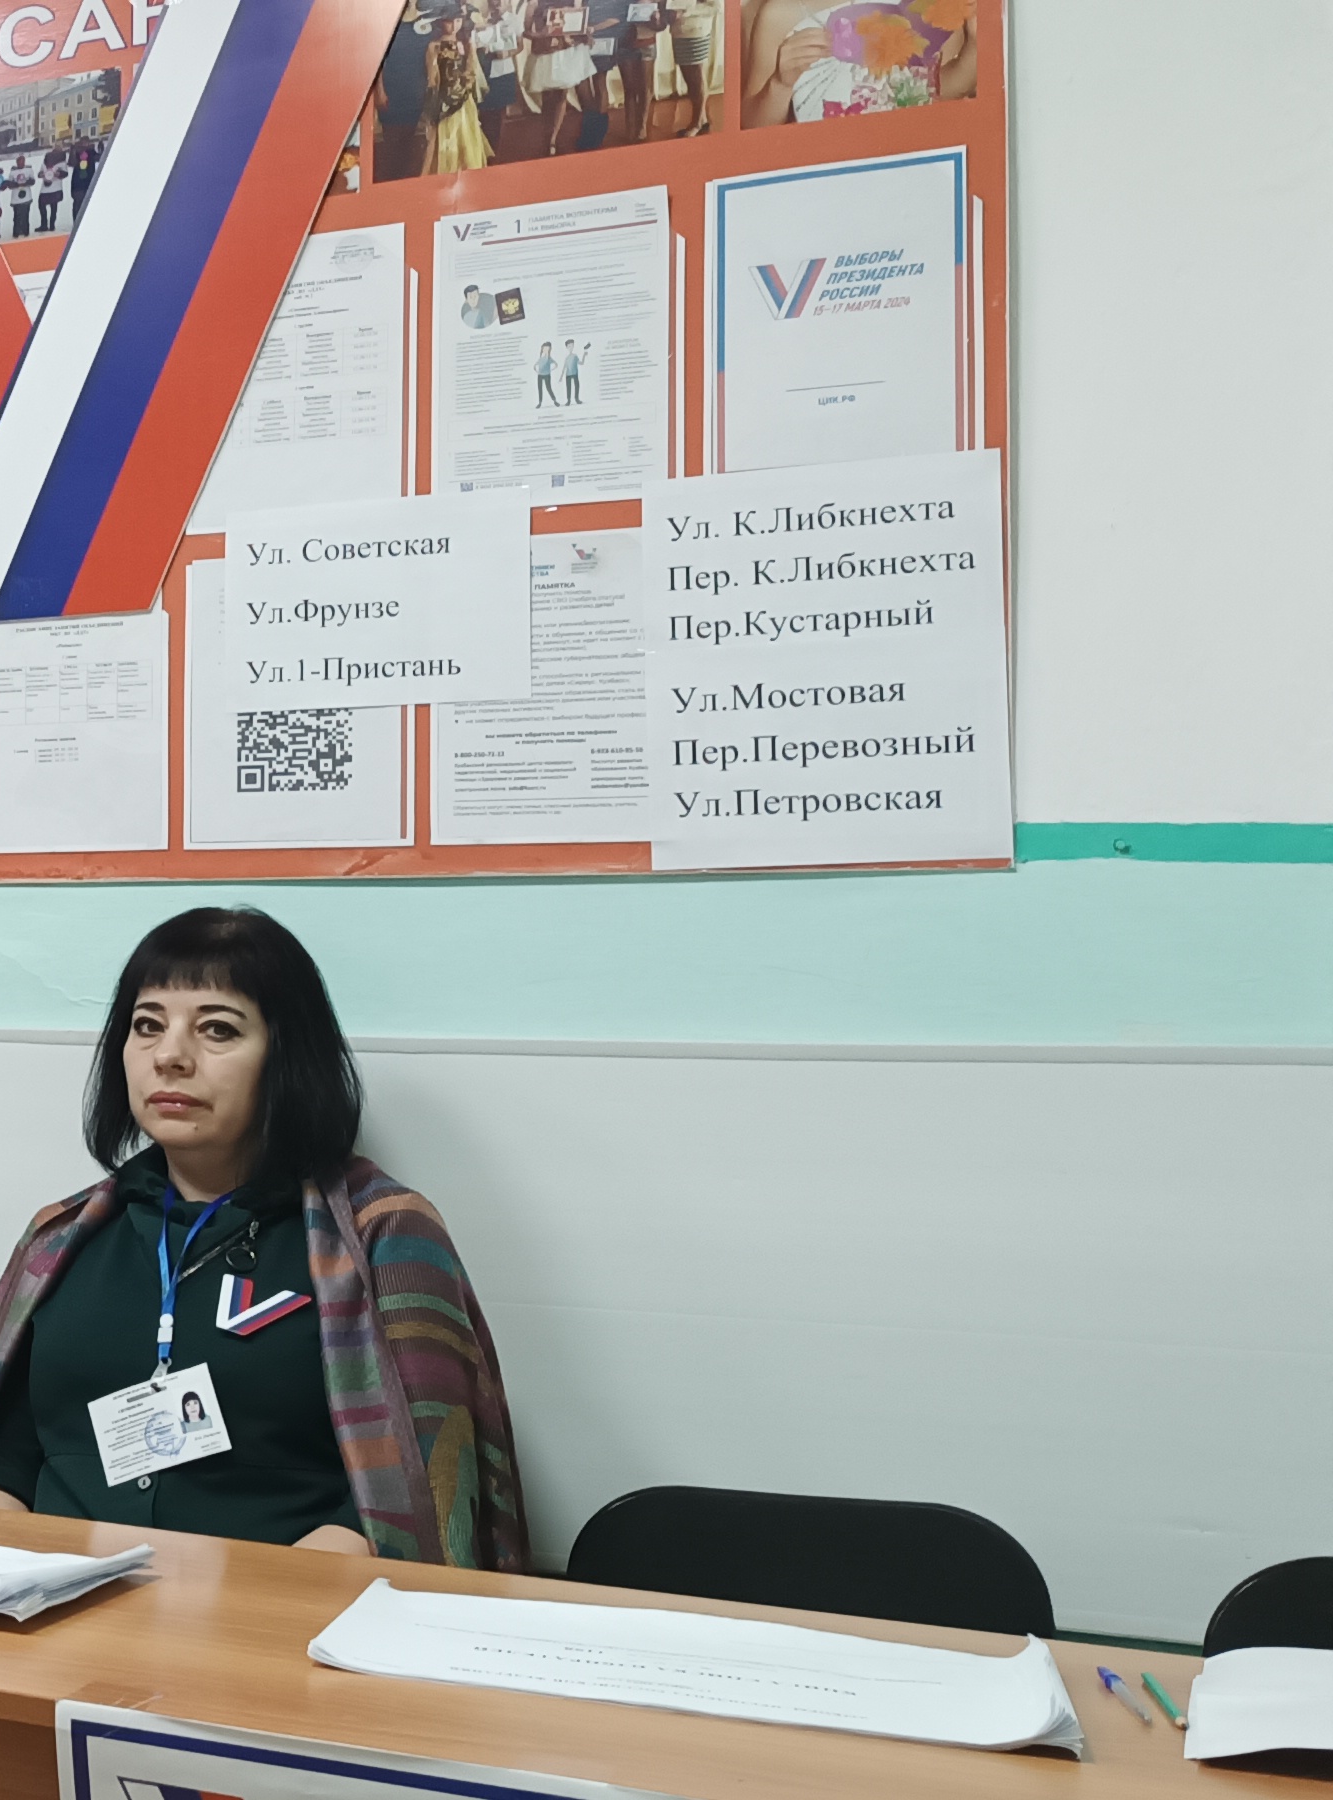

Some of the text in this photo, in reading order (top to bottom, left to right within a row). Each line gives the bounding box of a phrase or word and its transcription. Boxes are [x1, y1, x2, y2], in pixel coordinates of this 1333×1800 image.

[826, 262, 925, 285] ПРЕЗИДЕНТА
[834, 248, 904, 269] ВЫБОРЫ
[818, 283, 882, 302] РОССИИ
[844, 299, 881, 313] МАРТА
[883, 296, 911, 310] 2024
[667, 499, 956, 542] Ул. К.Либкнехта
[246, 534, 452, 567] Ул. Советская
[667, 550, 977, 596] Пер. К.Либкнехта
[246, 599, 401, 627] Ул.Фрунзе
[668, 599, 935, 645] Пер.Кустарный
[246, 655, 462, 686] Ул.1-Пристань
[671, 681, 906, 714] Ул.Мостовая
[672, 726, 976, 771] Пер.Перевозный
[674, 789, 944, 822] Ул.Петровская
